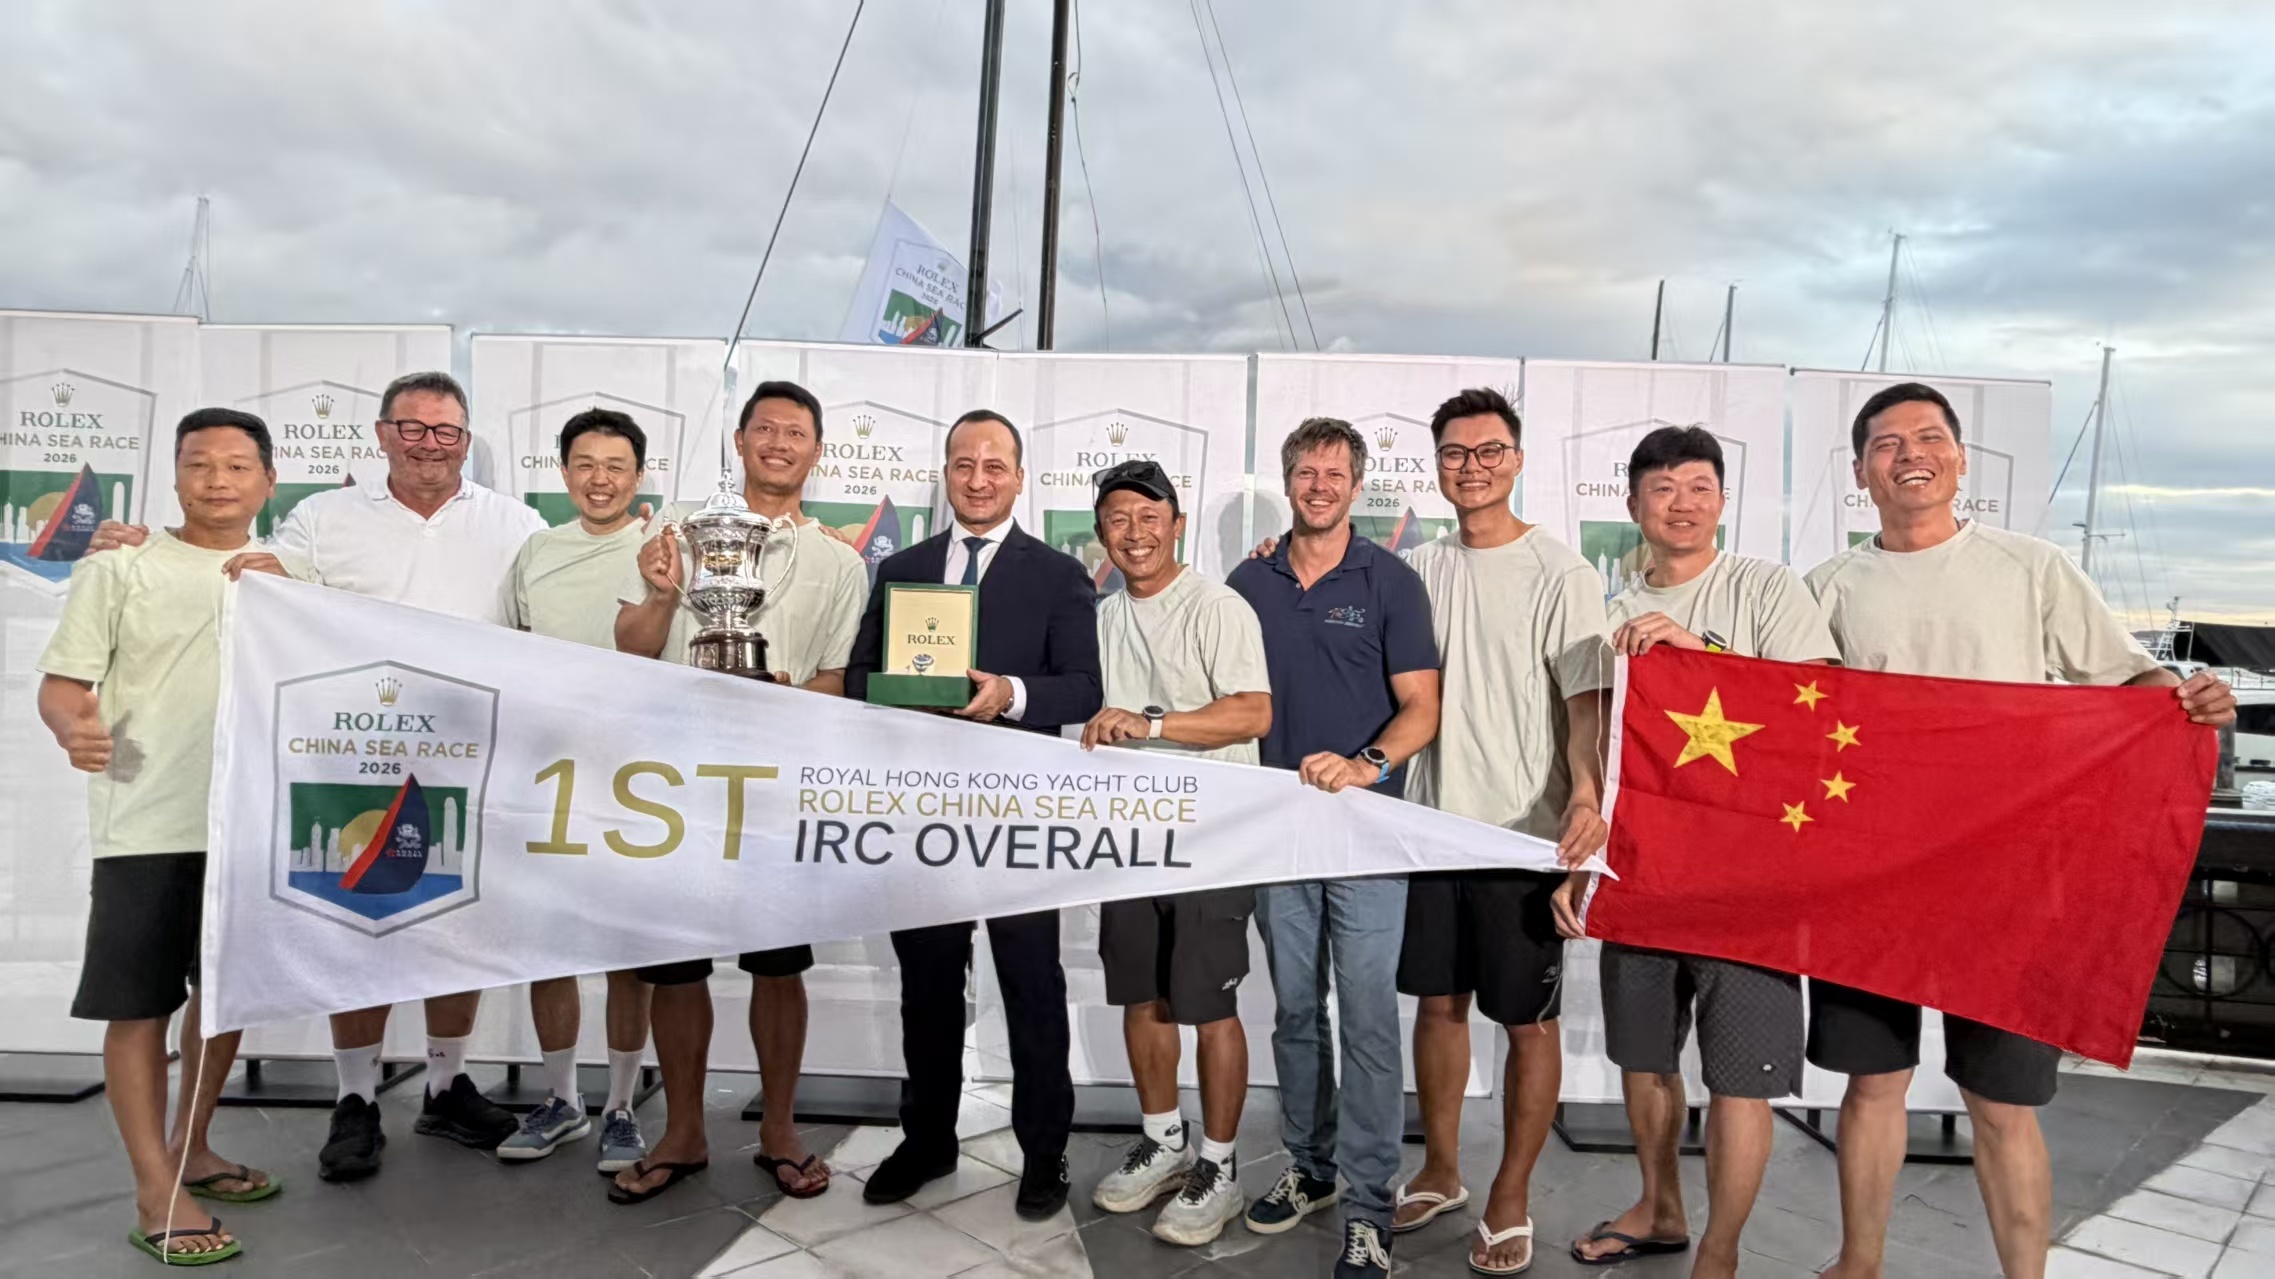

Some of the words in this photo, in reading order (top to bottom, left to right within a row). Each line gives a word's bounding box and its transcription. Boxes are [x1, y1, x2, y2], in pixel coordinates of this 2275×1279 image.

[895, 267, 924, 288] CHINA
[926, 283, 944, 298] SEA
[20, 411, 104, 429] ROLEX
[284, 424, 364, 440] ROLEX
[0, 432, 41, 447] HINA
[48, 434, 83, 448] SEA
[90, 436, 139, 450] RACE
[44, 453, 77, 463] 2026
[275, 446, 305, 459] INA
[310, 446, 345, 460] SEA
[351, 447, 387, 460] RAC
[822, 443, 904, 461] ROLEX
[308, 465, 340, 475] 2026
[521, 456, 561, 469] CHIN
[1364, 456, 1426, 473] OLEX
[810, 465, 842, 478] INA
[848, 466, 883, 480] SEA
[890, 468, 939, 482] RACE
[844, 485, 877, 495] 2026
[1371, 479, 1407, 492] SEA
[1413, 480, 1438, 493] RA
[1367, 498, 1400, 508] 2026
[1953, 499, 1999, 513] RACE
[907, 634, 956, 645] ROLEX
[332, 712, 436, 733] ROLEX
[288, 738, 357, 755] CHINA
[365, 740, 408, 756] SEA
[416, 742, 479, 759] RACE
[358, 762, 402, 775] 2026
[800, 767, 877, 786] ROYAL
[885, 770, 959, 789] HONG
[968, 772, 1038, 790] KONG
[1046, 774, 1128, 792] YACHT
[1133, 775, 1198, 793] CLUB
[526, 759, 779, 860] 1ST
[799, 789, 907, 815] ROLEX
[916, 792, 1023, 819] CHINA
[1034, 795, 1098, 820] SEA
[1109, 798, 1197, 822] RACE
[795, 820, 895, 865] IRC
[915, 823, 1192, 870] OVERALL
